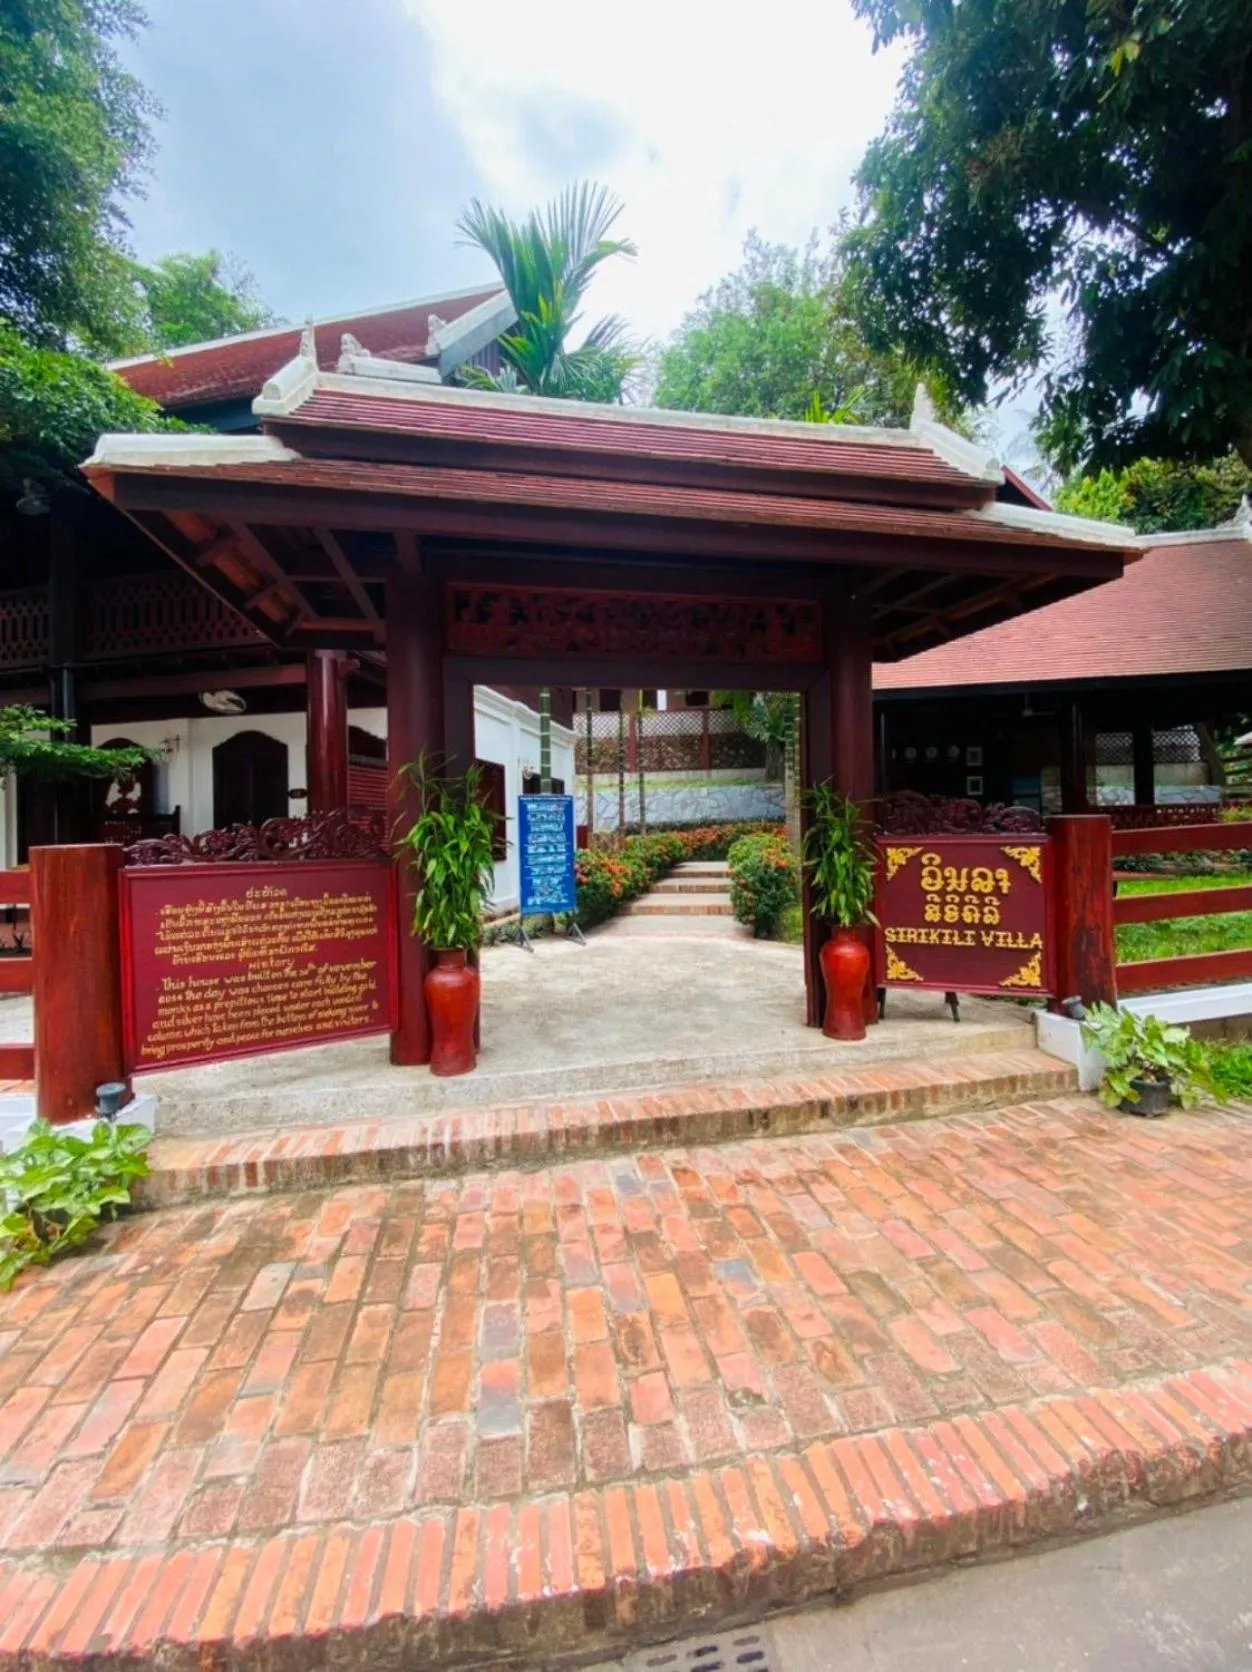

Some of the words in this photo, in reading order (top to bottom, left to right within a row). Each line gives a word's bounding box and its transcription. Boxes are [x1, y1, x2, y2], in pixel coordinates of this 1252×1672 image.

[884, 927, 976, 946] SIRIKILI
[980, 930, 1043, 949] VILLA
[162, 976, 185, 991] This
[188, 976, 220, 988] house
[224, 975, 246, 983] was
[203, 987, 226, 1001] day
[228, 988, 250, 996] was
[152, 1014, 175, 1029] and
